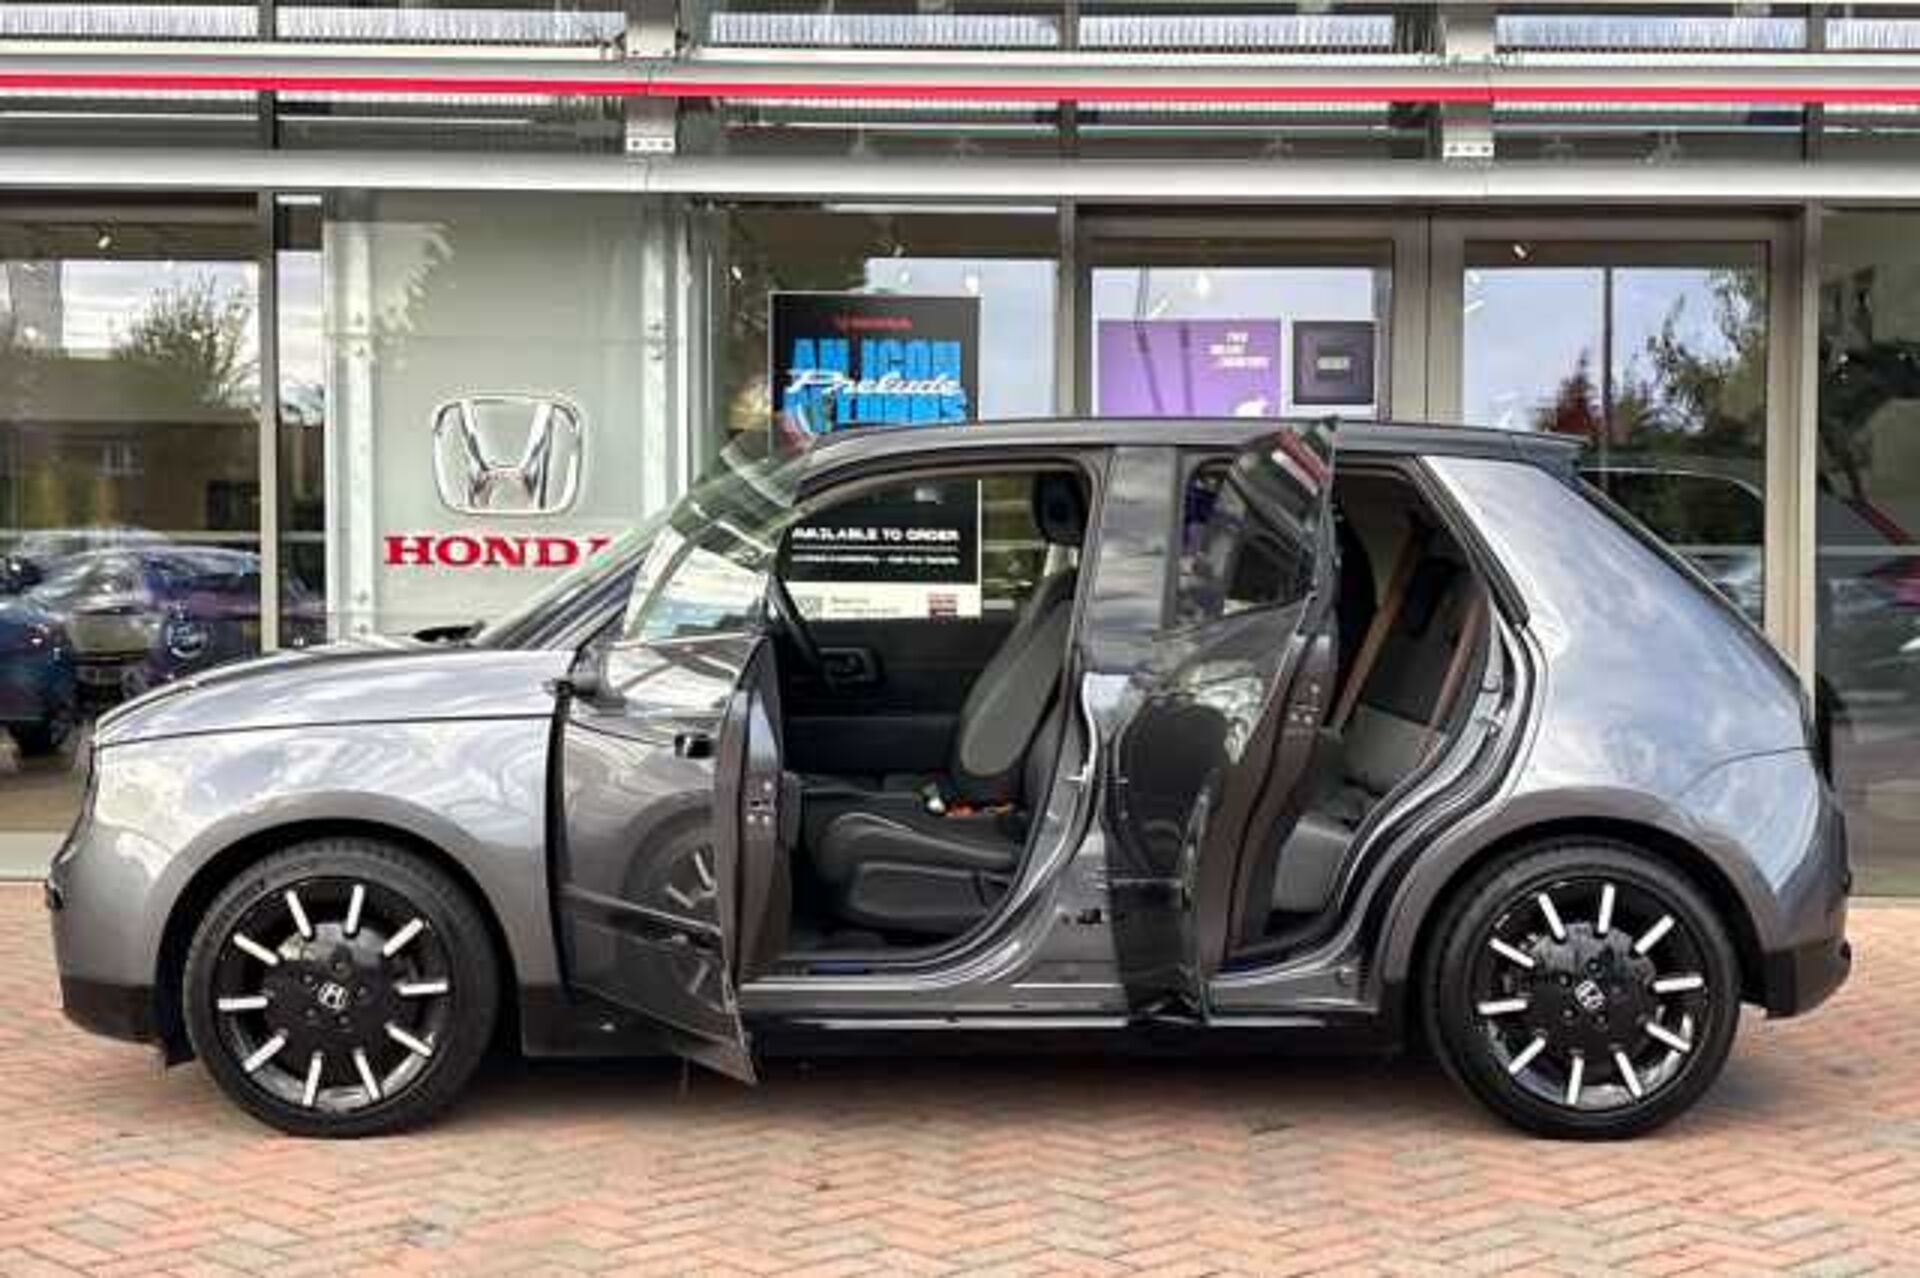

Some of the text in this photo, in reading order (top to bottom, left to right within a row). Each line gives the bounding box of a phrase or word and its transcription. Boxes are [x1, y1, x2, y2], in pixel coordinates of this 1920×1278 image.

[785, 367, 966, 394] Prelude
[791, 527, 961, 542] AVAILABLE TO ORDER
